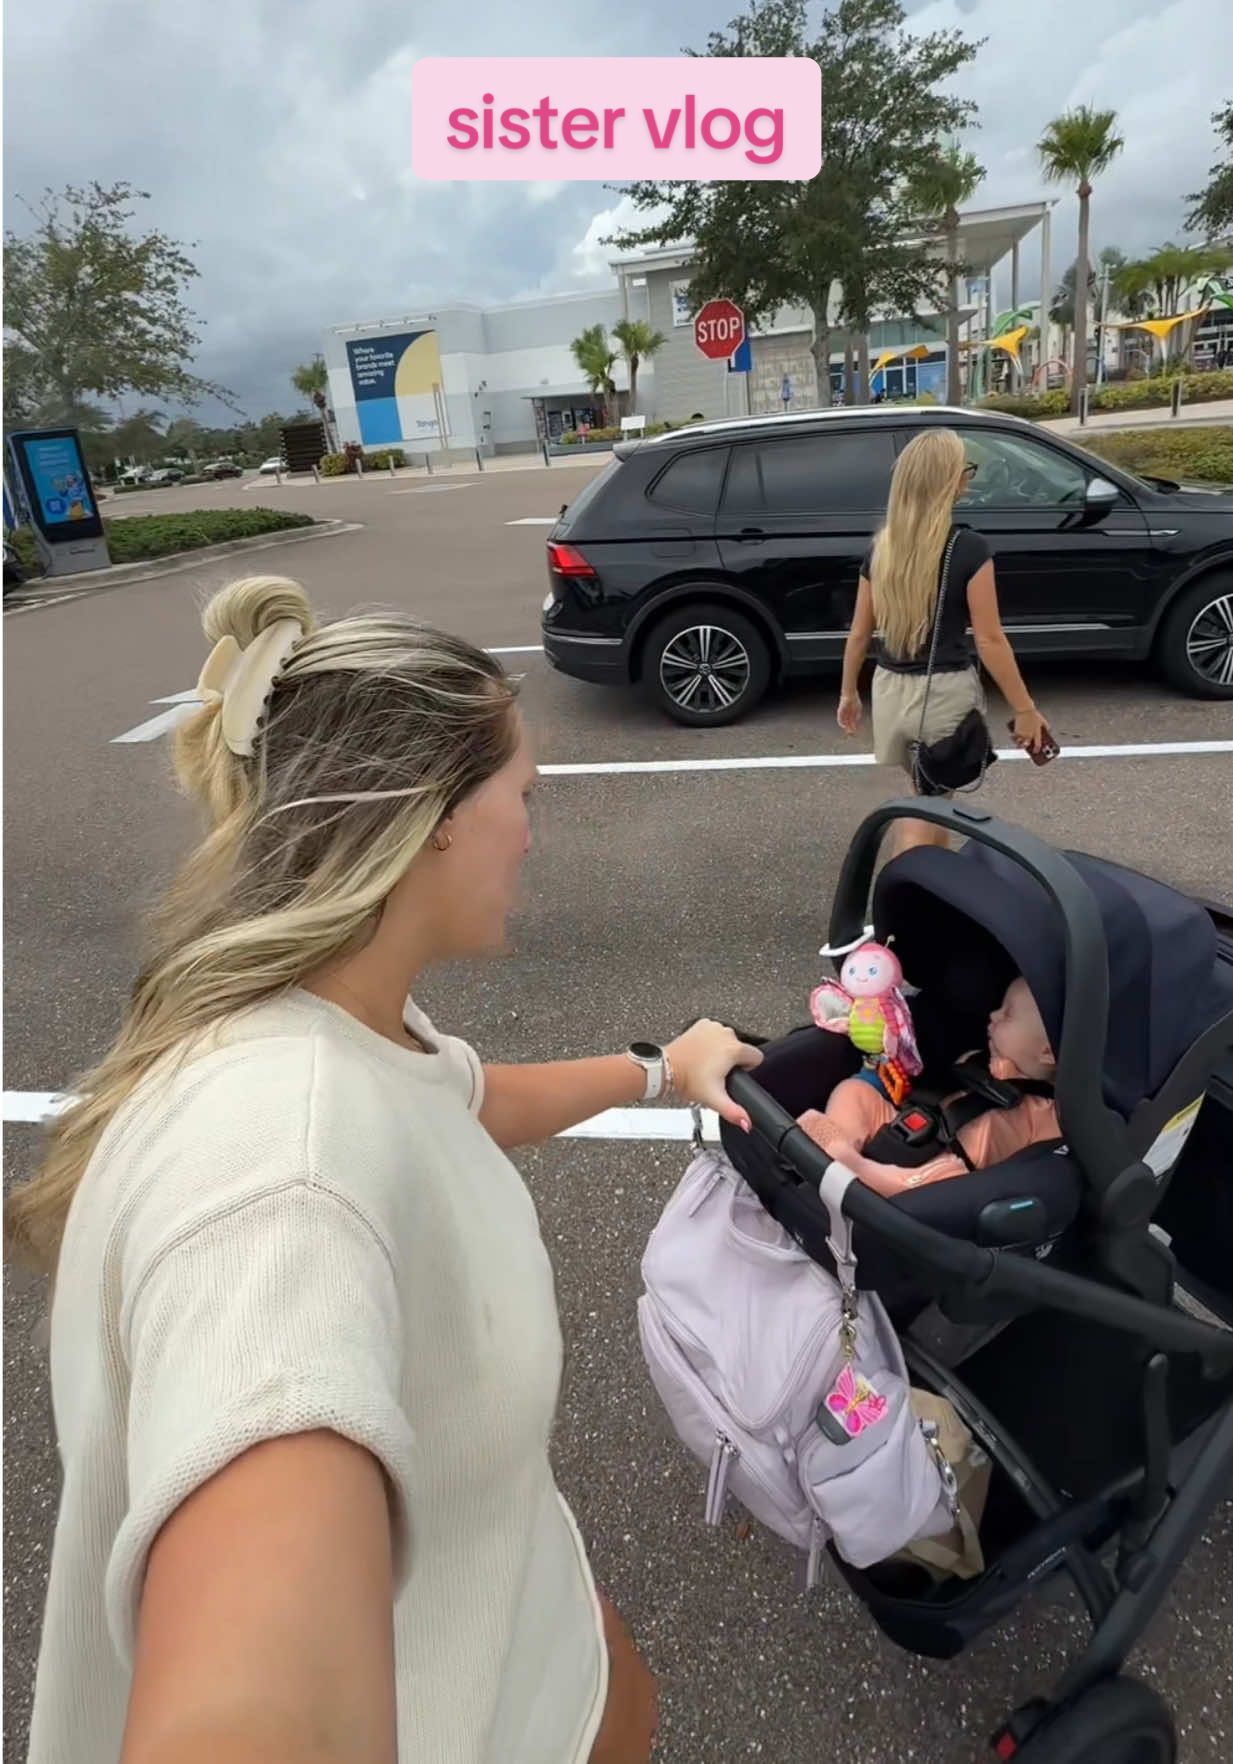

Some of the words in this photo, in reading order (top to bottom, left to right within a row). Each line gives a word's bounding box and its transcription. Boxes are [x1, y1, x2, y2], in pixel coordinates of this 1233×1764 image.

[697, 316, 740, 344] STOP
[353, 347, 375, 355] Where
[355, 356, 369, 364] your
[369, 352, 394, 360] favorite
[356, 362, 378, 370] brands
